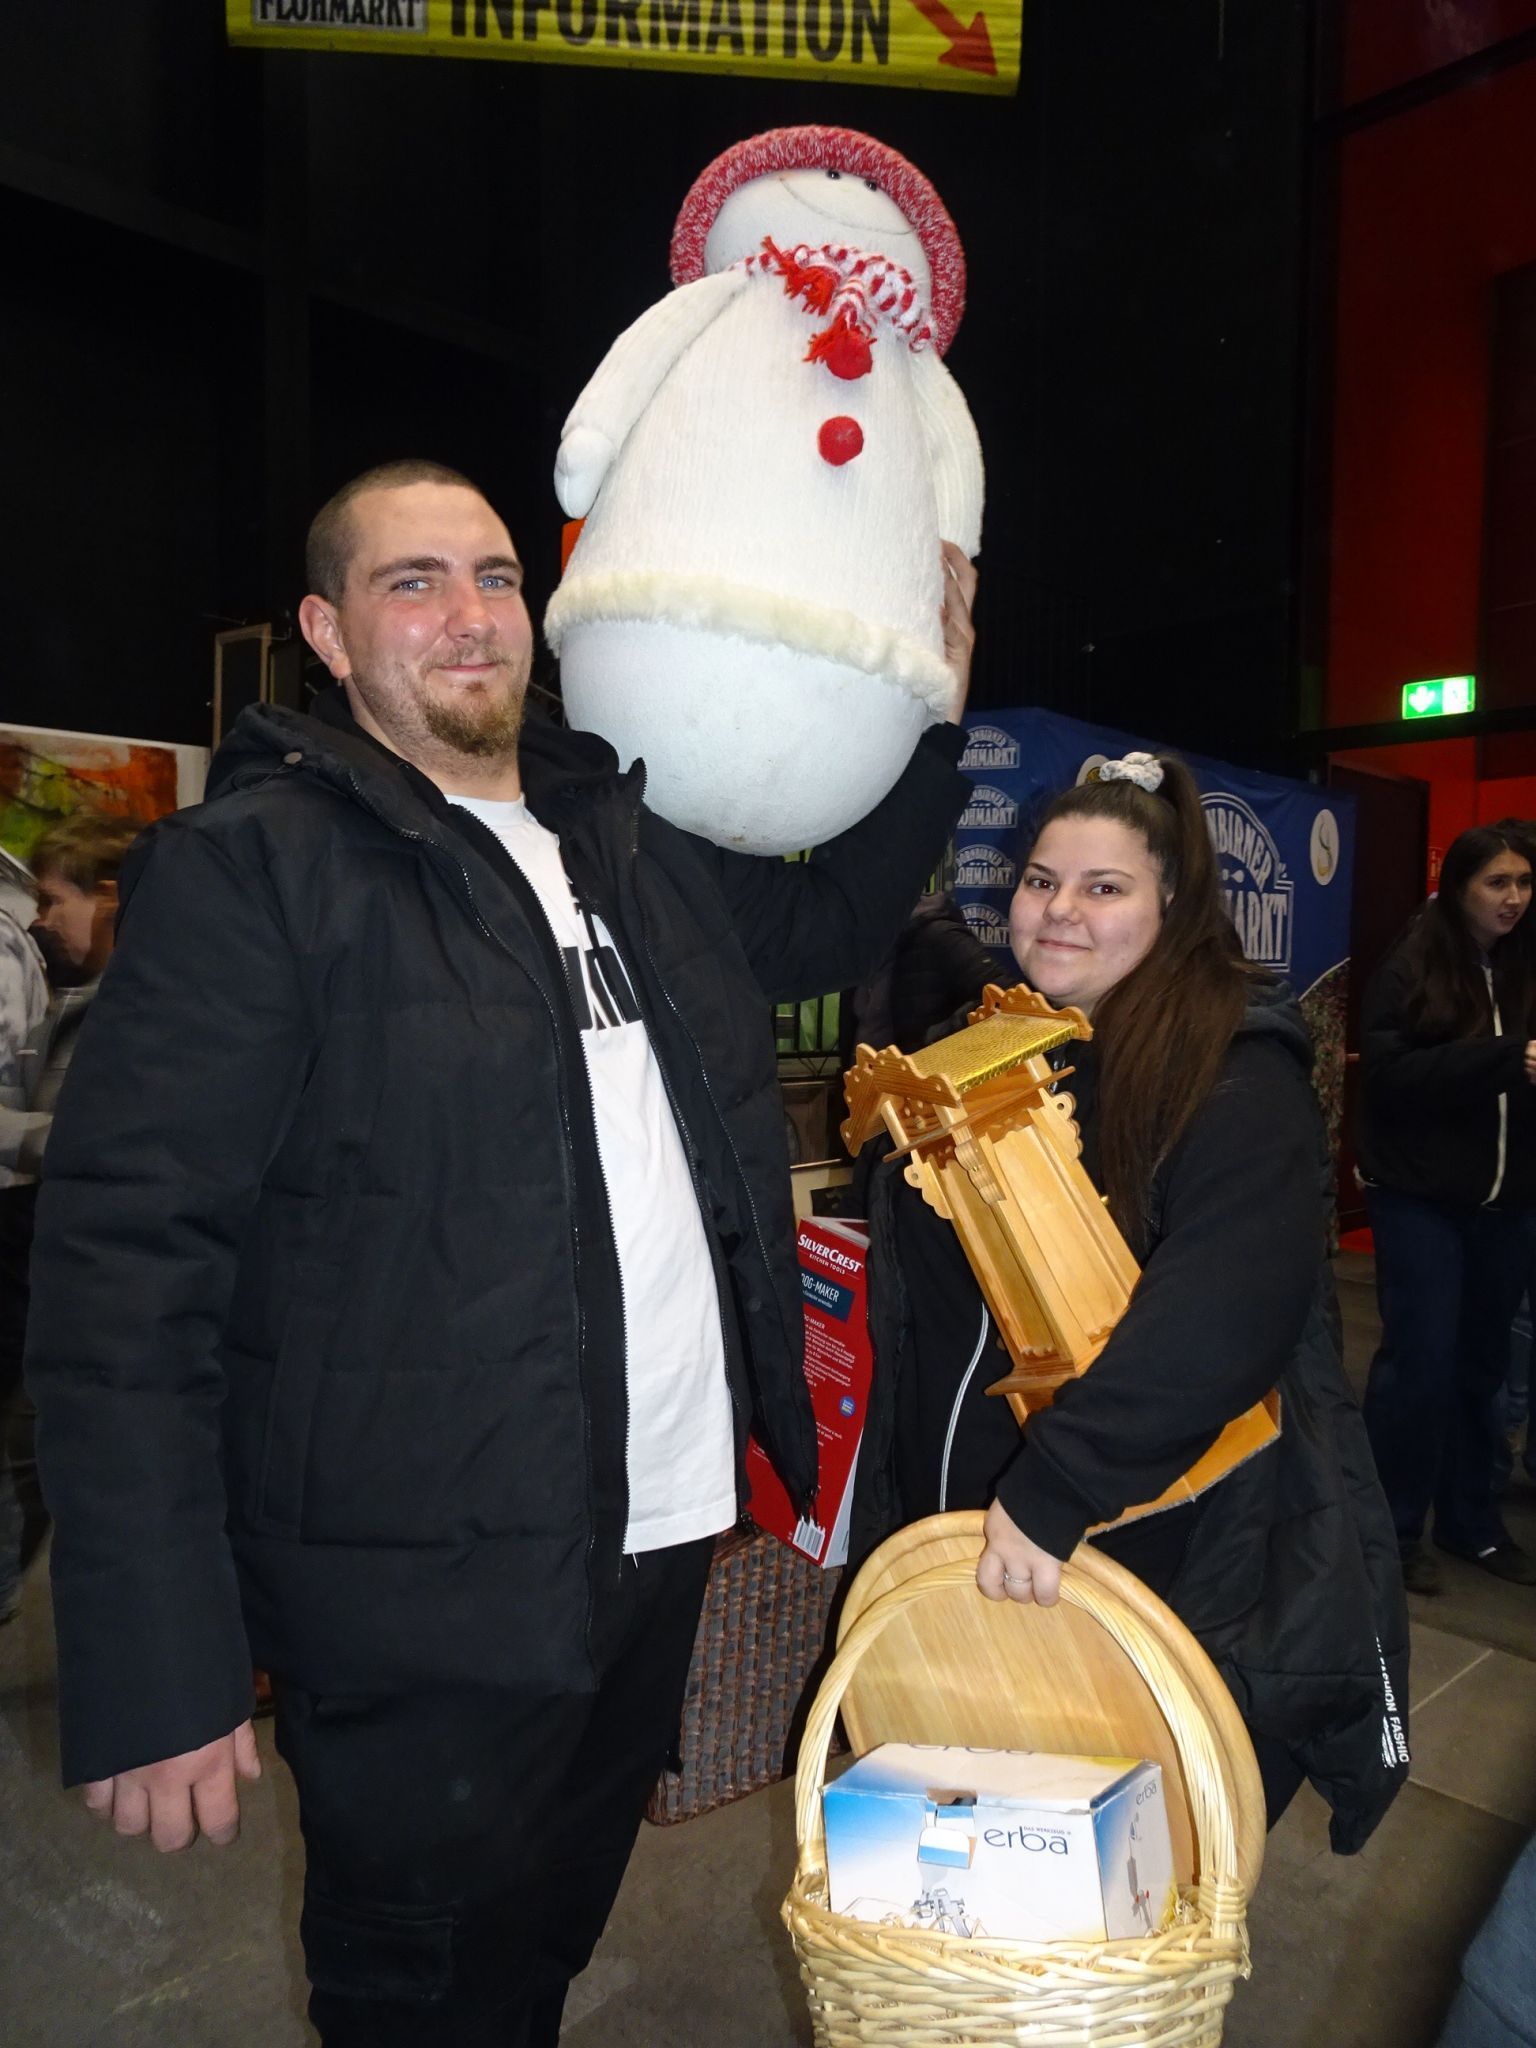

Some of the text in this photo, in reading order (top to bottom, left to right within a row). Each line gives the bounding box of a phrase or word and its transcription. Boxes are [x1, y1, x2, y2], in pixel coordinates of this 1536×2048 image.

[452, 0, 889, 65] INFORMATION
[1205, 808, 1272, 892] NBIRNER
[798, 1234, 861, 1272] SILVERCREST
[829, 1263, 846, 1275] TOOLS
[1135, 1780, 1157, 1806] erba
[984, 1826, 1069, 1856] erba
